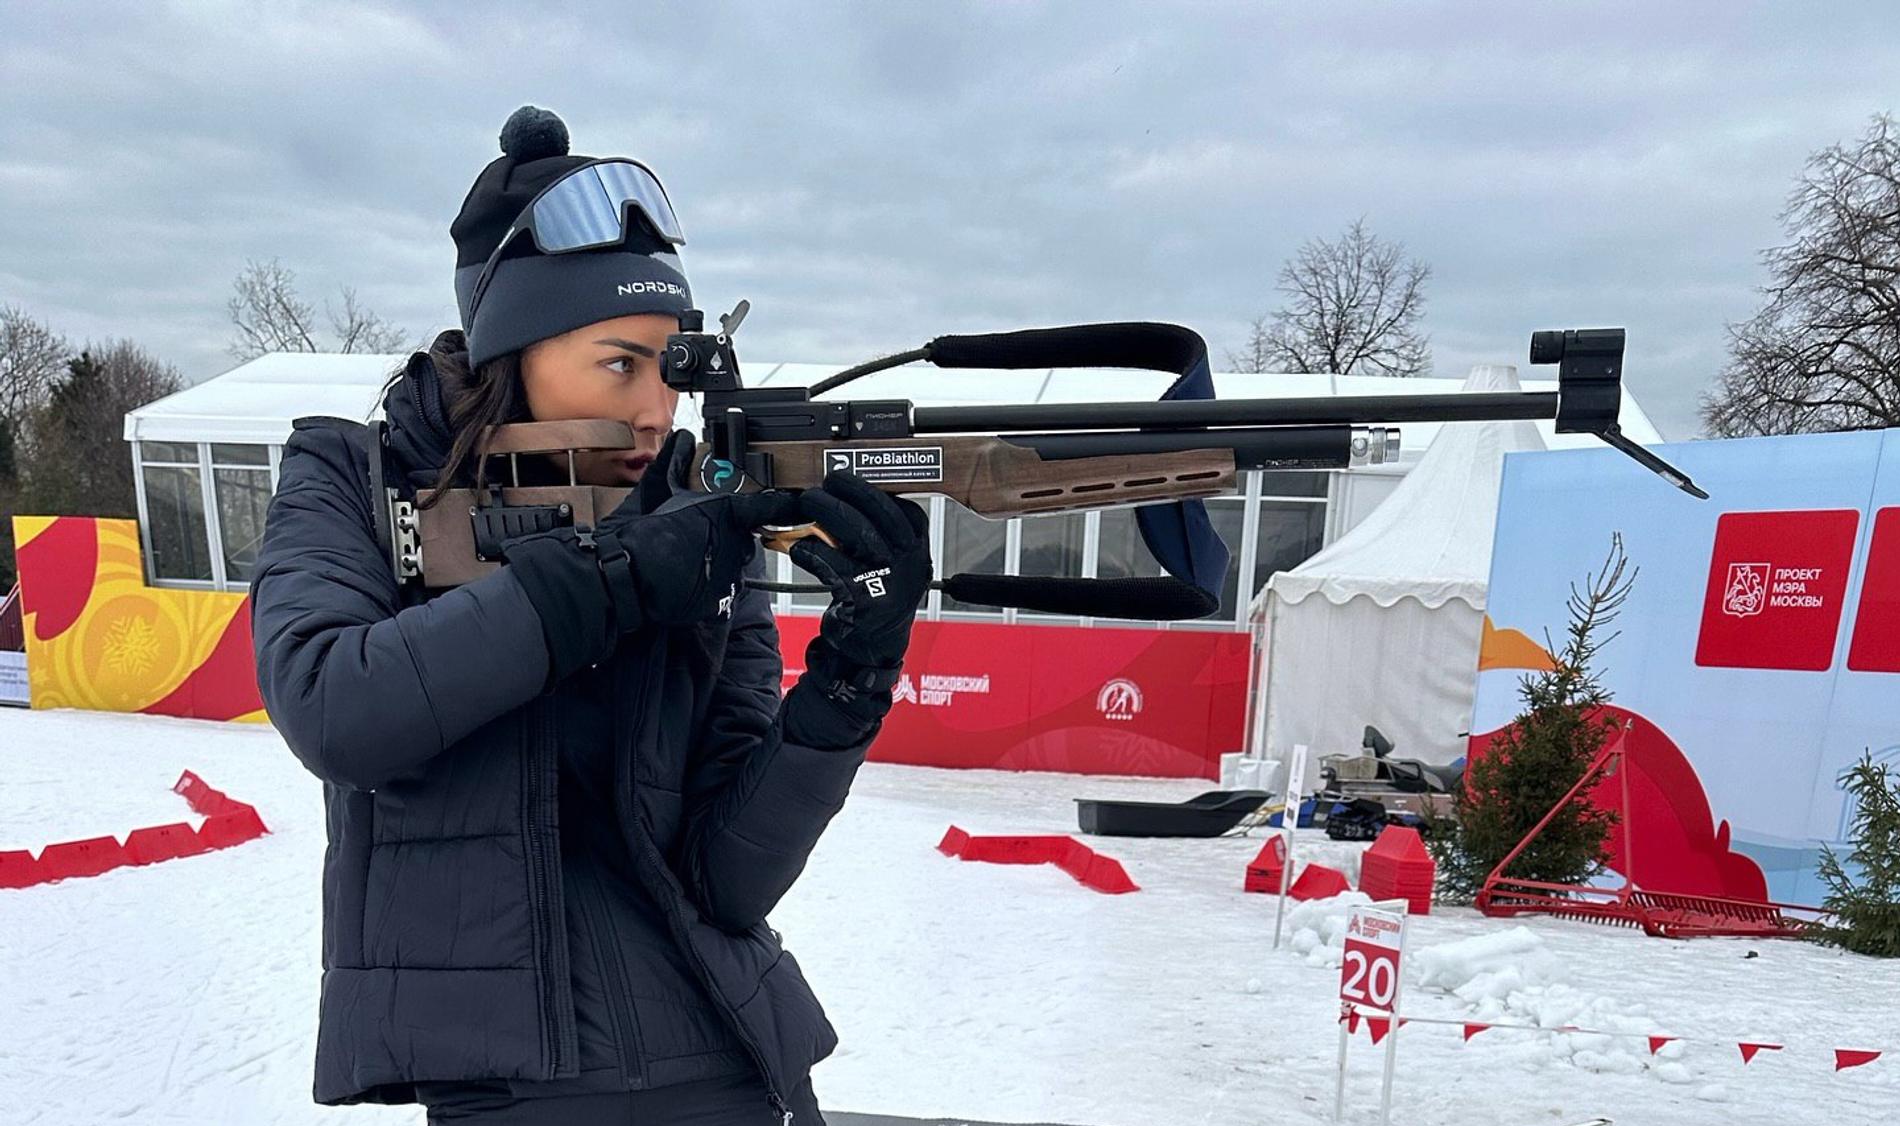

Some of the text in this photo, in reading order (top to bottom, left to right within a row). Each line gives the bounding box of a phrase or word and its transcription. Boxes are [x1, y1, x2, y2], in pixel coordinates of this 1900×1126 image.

[861, 452, 935, 465] ProBiathlon
[1775, 568, 1823, 580] ПРОЕКТ
[1772, 582, 1807, 593] МЭРА
[1770, 595, 1824, 607] МОСКВЫ
[921, 674, 990, 694] МОСКОВСКИЙ
[920, 689, 954, 707] СПОРТ
[1342, 950, 1396, 1006] 20
